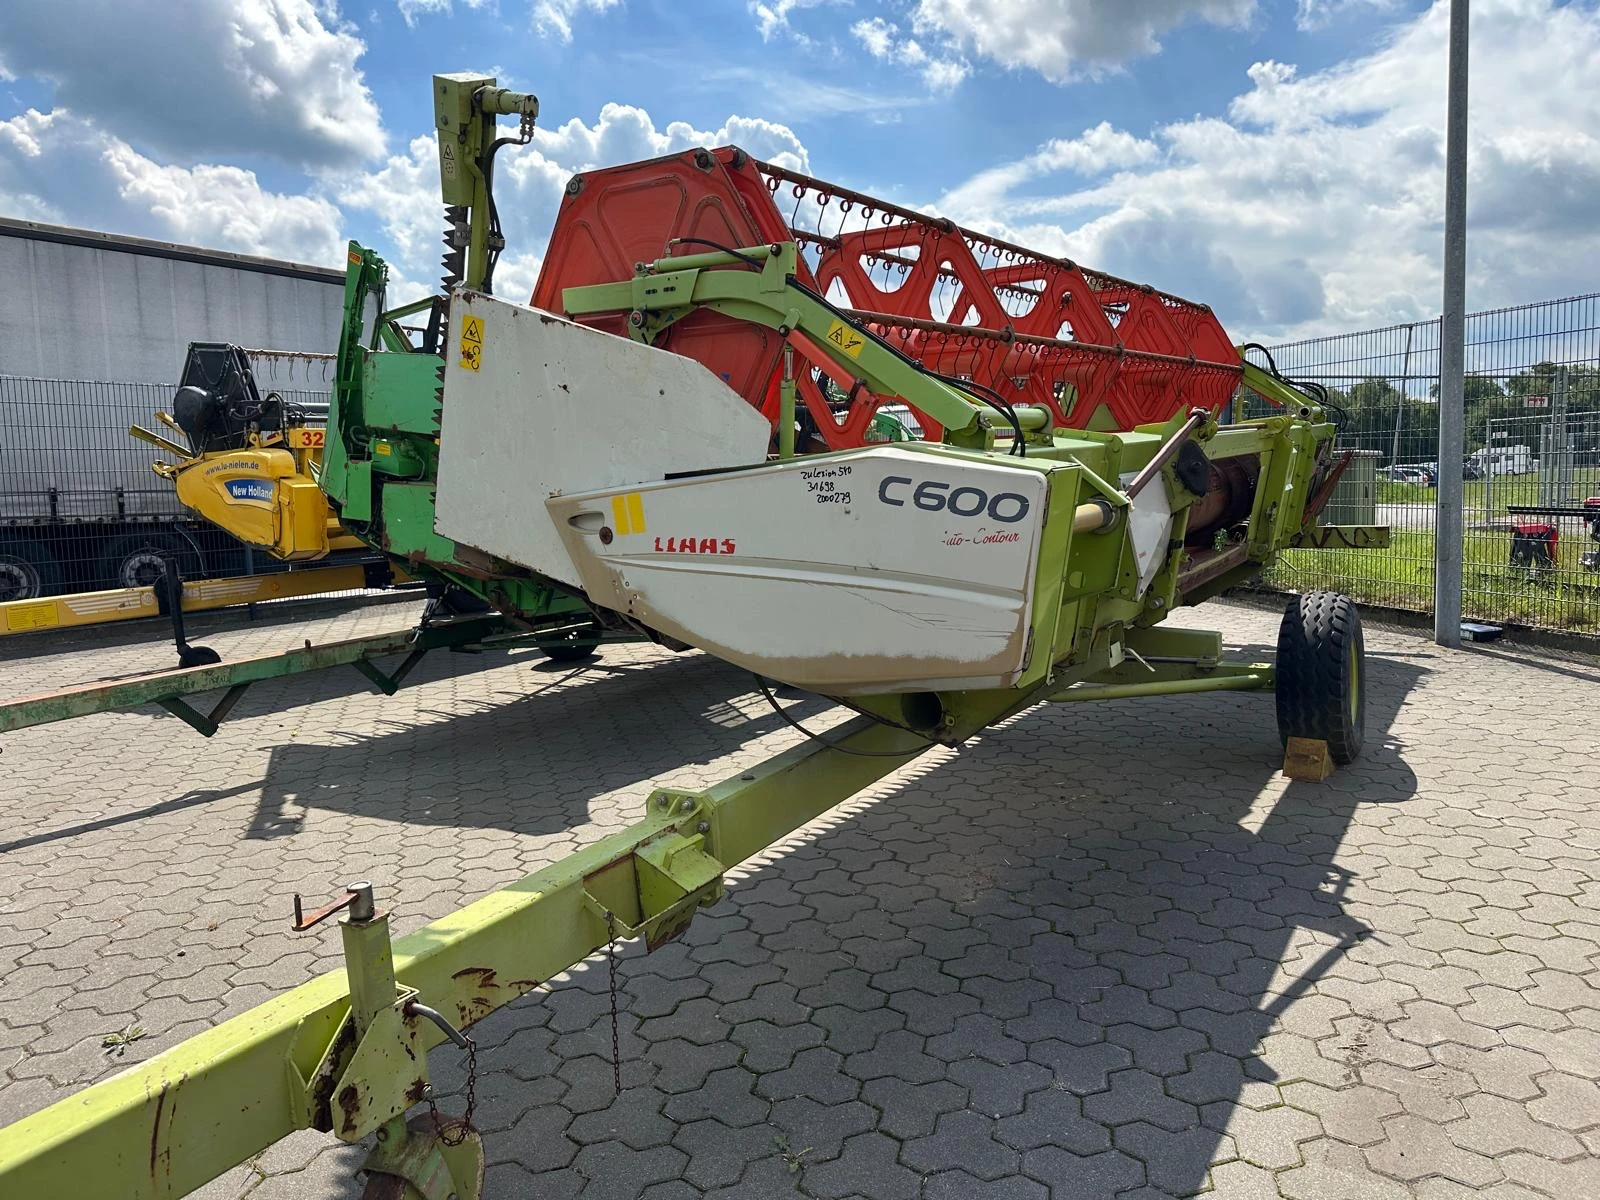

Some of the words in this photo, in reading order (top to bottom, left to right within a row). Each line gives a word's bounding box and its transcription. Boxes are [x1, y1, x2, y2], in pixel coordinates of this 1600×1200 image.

[232, 485, 247, 497] New
[248, 485, 273, 499] Holland
[808, 481, 834, 492] 31698
